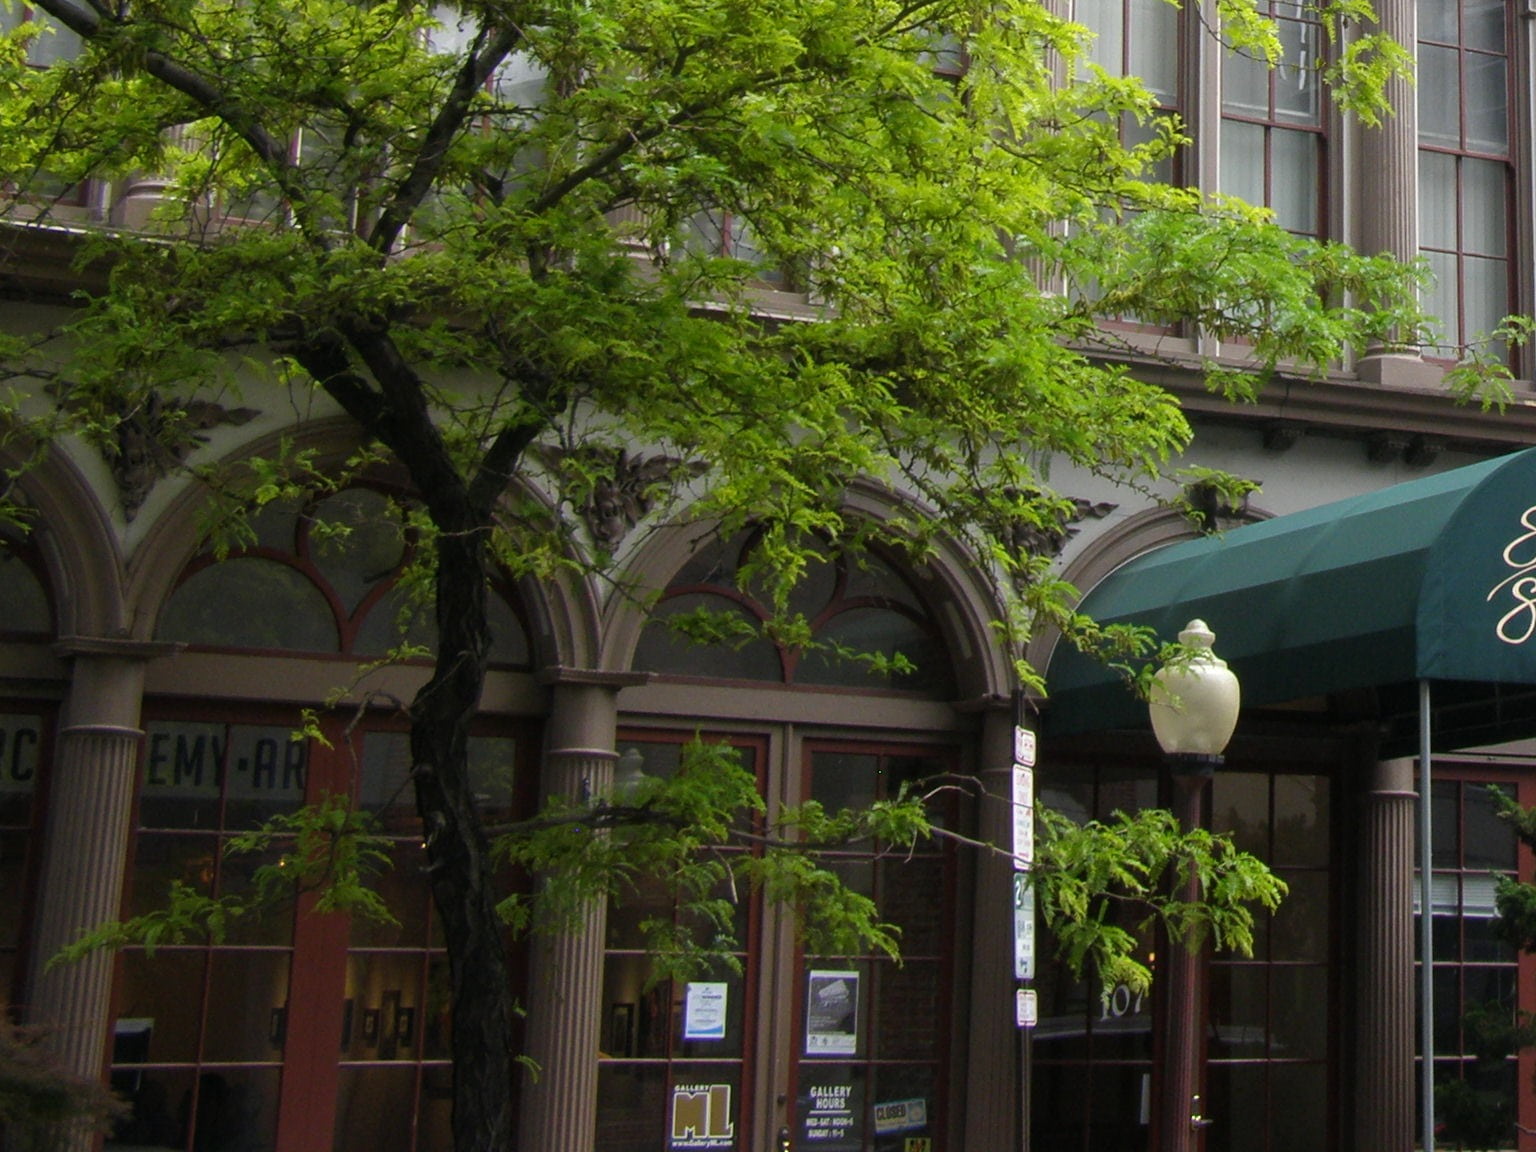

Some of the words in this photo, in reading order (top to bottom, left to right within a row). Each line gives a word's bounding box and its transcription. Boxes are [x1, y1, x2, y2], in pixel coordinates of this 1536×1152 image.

[674, 1084, 709, 1092] GALLERY
[810, 1086, 852, 1098] GALLERY
[816, 1098, 846, 1109] HOURS
[876, 1104, 906, 1120] CLOSED
